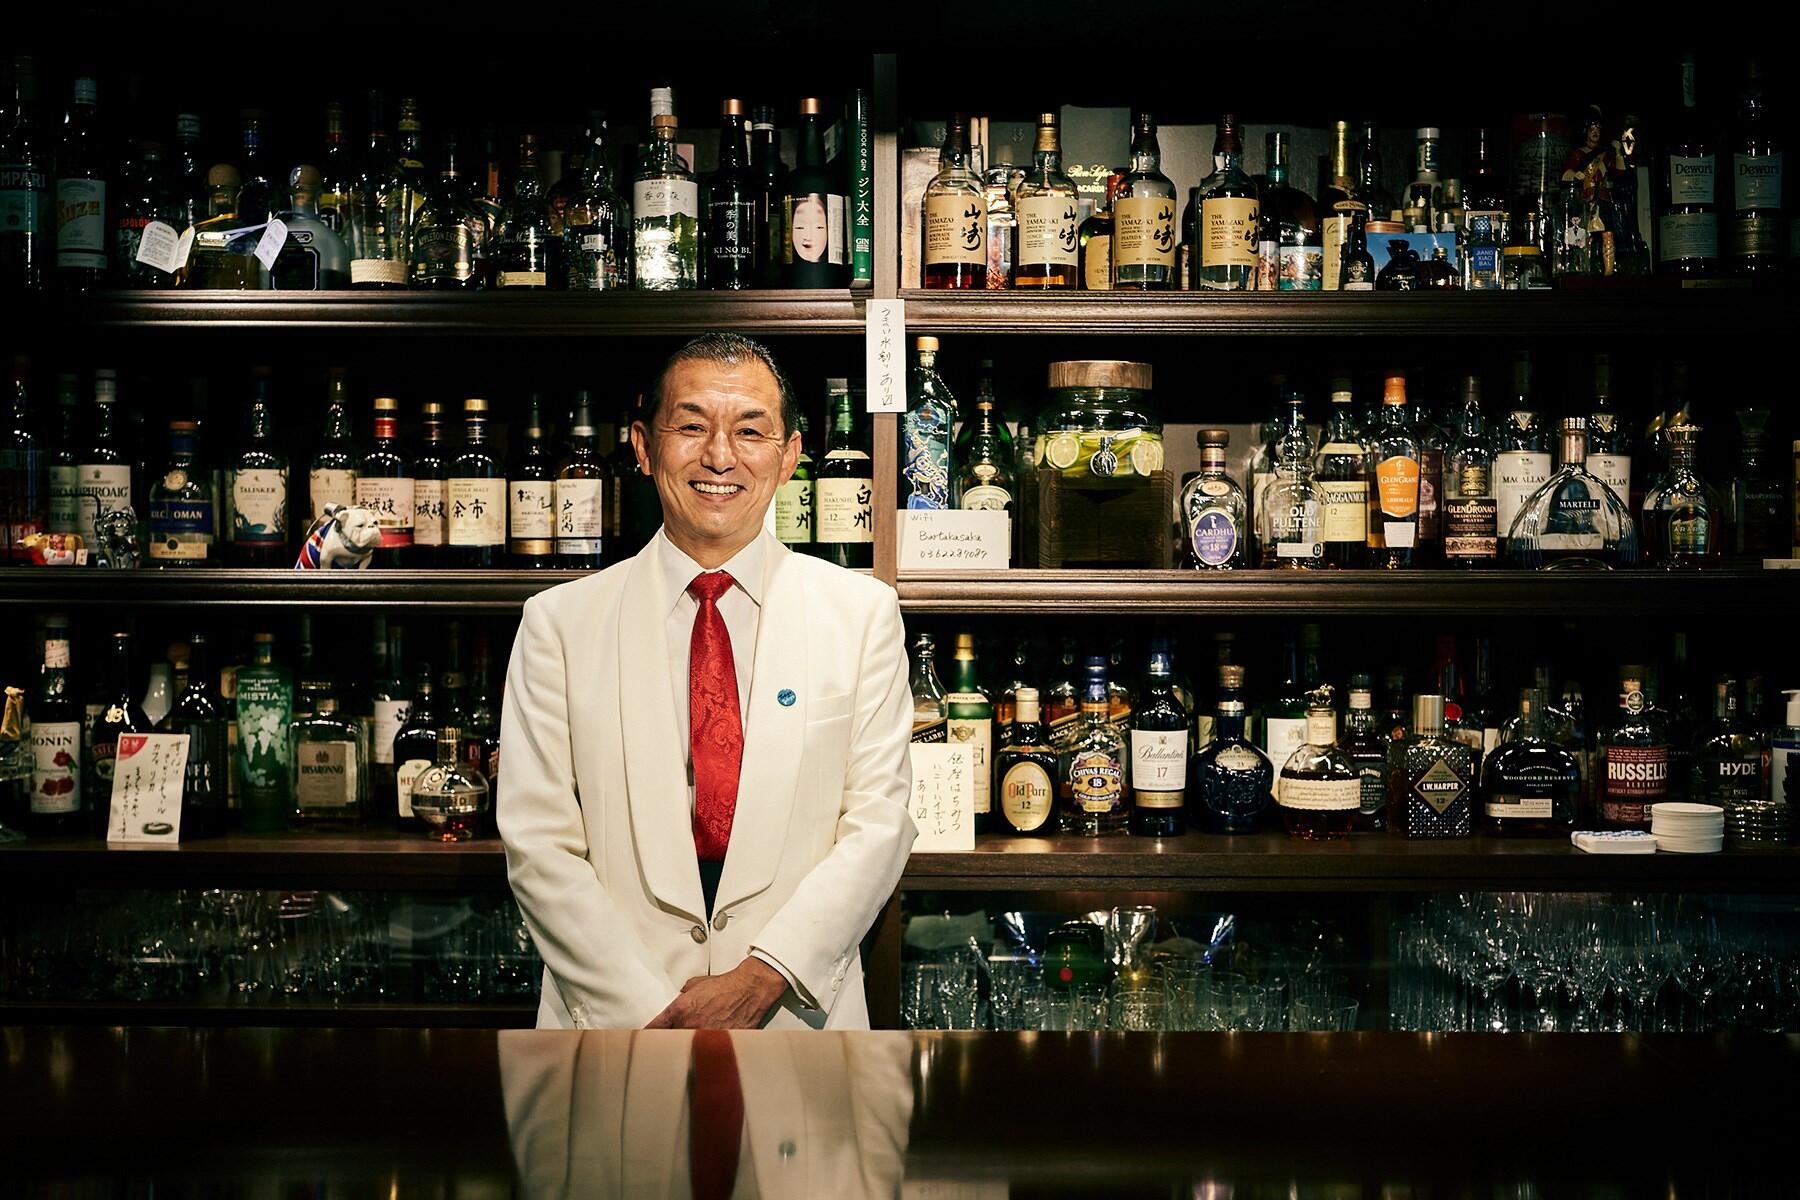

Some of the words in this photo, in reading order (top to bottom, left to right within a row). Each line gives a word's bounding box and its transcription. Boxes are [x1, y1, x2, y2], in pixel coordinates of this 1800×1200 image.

[0, 170, 46, 188] MPARI
[856, 176, 870, 226] ジン大全
[960, 202, 984, 252] 山崎
[1058, 204, 1078, 252] 山崎
[1152, 204, 1174, 254] 山崎
[724, 246, 738, 254] NO
[414, 500, 447, 520] 城峡
[452, 498, 487, 519] 余市
[854, 484, 872, 532] 白州
[1290, 506, 1314, 518] OLD
[1195, 528, 1234, 537] CARDHU
[1210, 543, 1220, 552] 18
[240, 692, 280, 701] MISTIA
[302, 766, 344, 774] DISARONNO
[1073, 767, 1098, 778] CHIVAS
[1099, 767, 1122, 778] REGAL
[1156, 766, 1168, 778] 17
[1720, 762, 1757, 776] HYDE
[1092, 778, 1103, 788] 18
[1008, 782, 1024, 800] Old
[1026, 782, 1046, 800] Parr
[1021, 801, 1031, 810] 12
